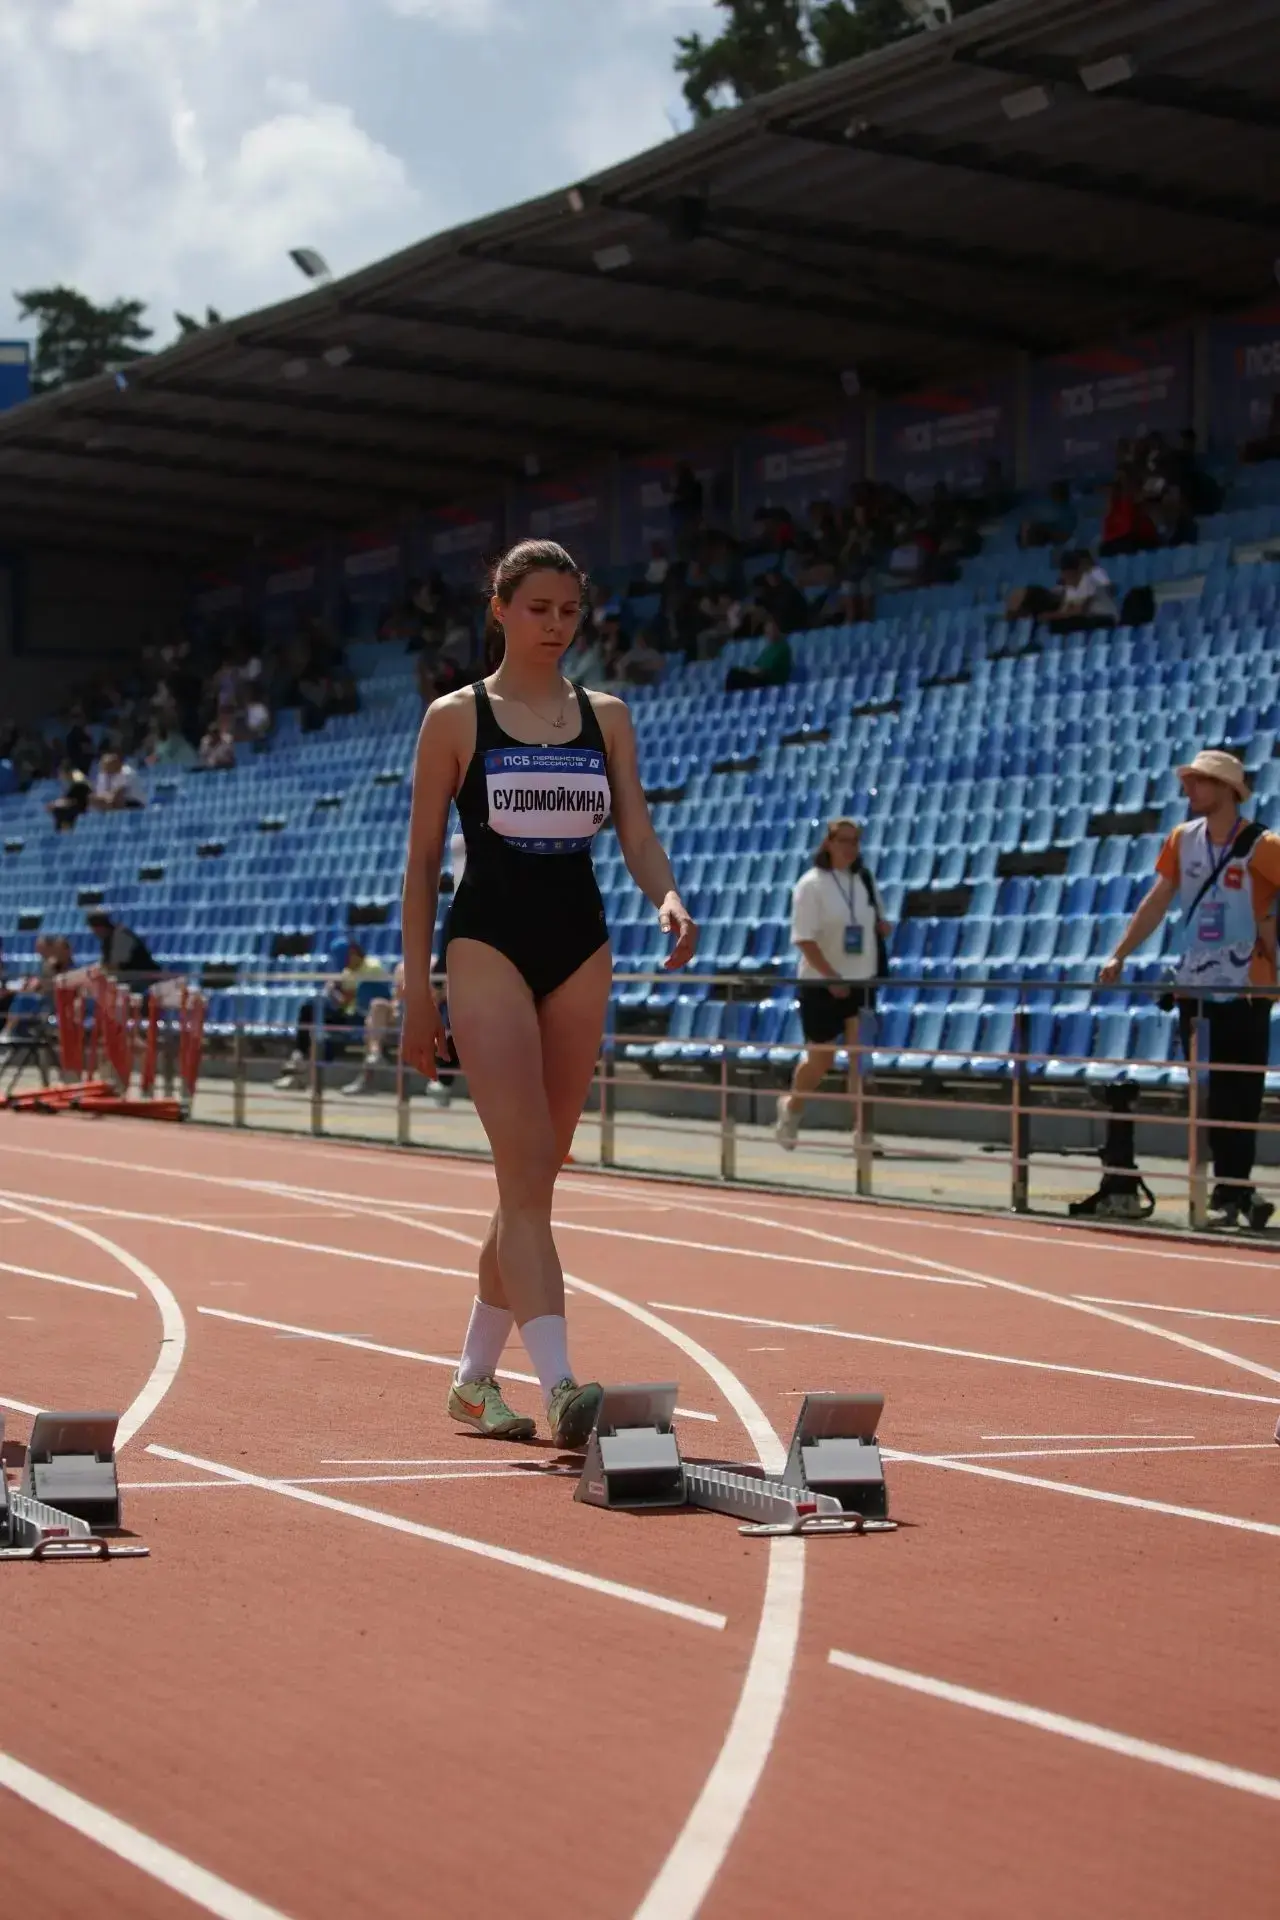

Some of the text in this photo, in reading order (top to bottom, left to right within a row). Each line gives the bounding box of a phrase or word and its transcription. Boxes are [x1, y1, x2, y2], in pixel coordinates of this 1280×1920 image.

[504, 756, 530, 766] ПСБ
[493, 787, 605, 812] СУДОМОЙКИНА
[592, 814, 603, 825] 89
